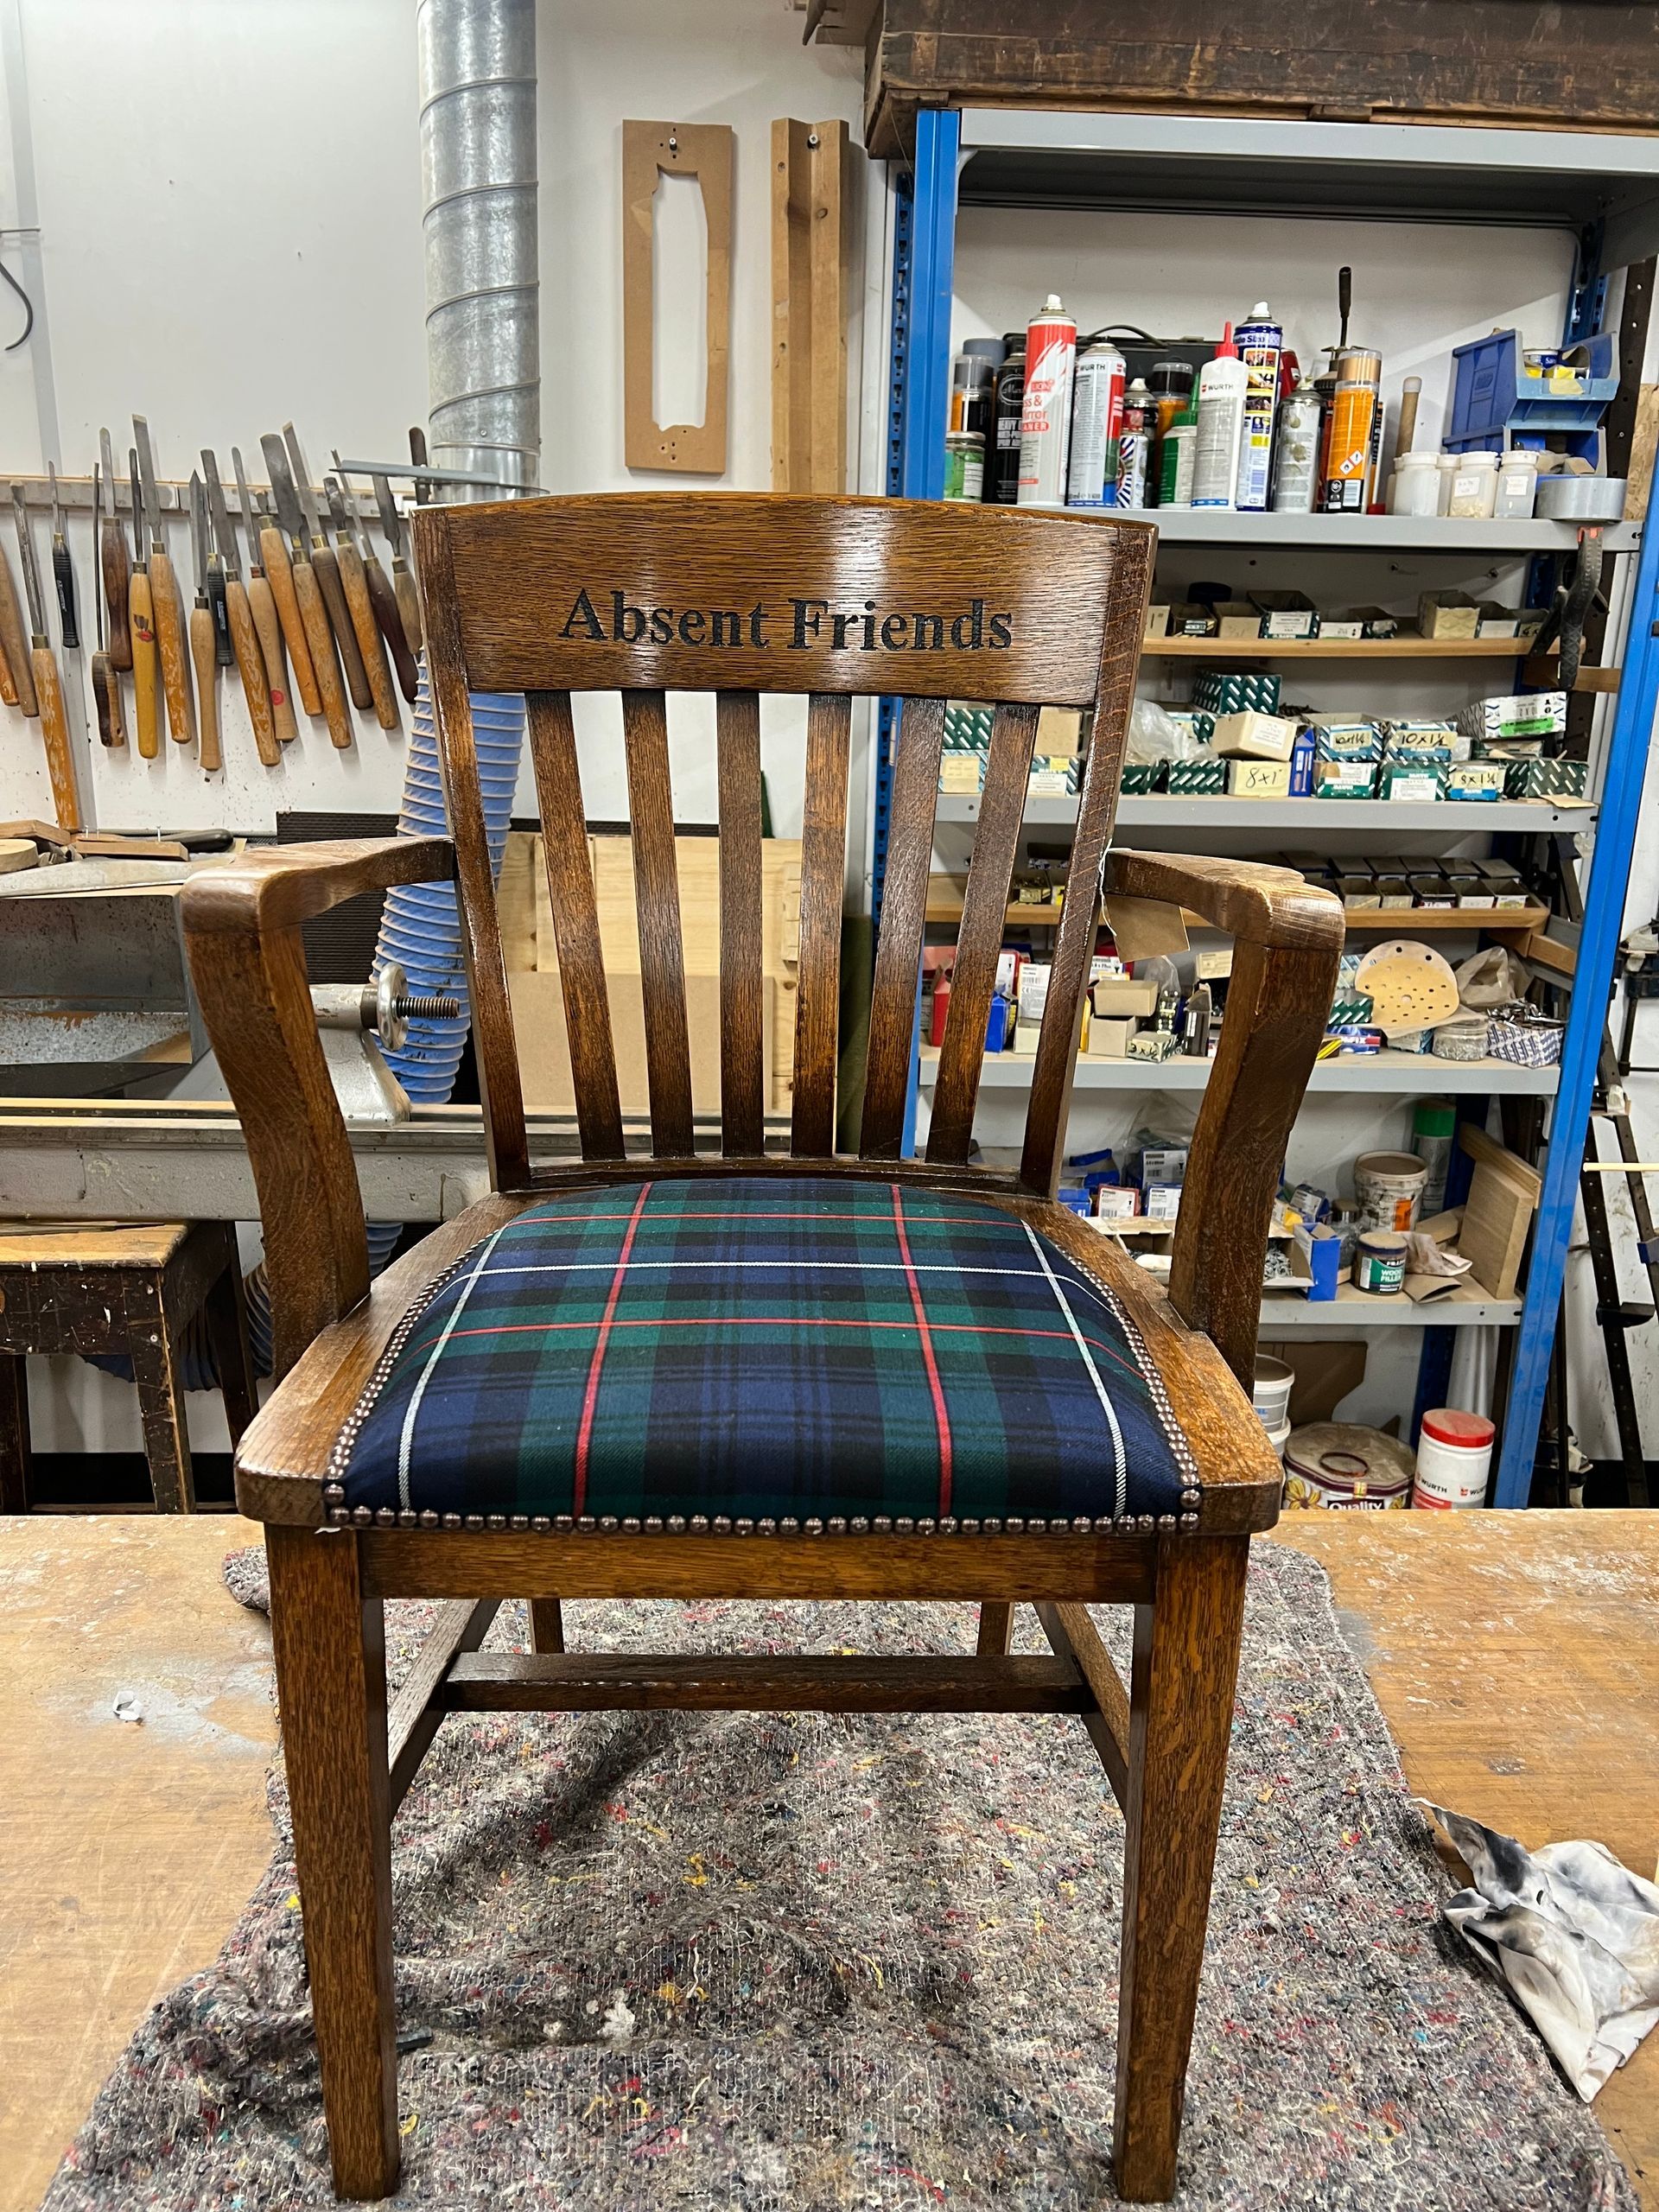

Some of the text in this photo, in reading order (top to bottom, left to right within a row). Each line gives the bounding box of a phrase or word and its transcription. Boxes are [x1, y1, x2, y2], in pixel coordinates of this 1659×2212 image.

[558, 588, 1013, 652] Absent Friends
[1328, 1501, 1382, 1510] Quality
